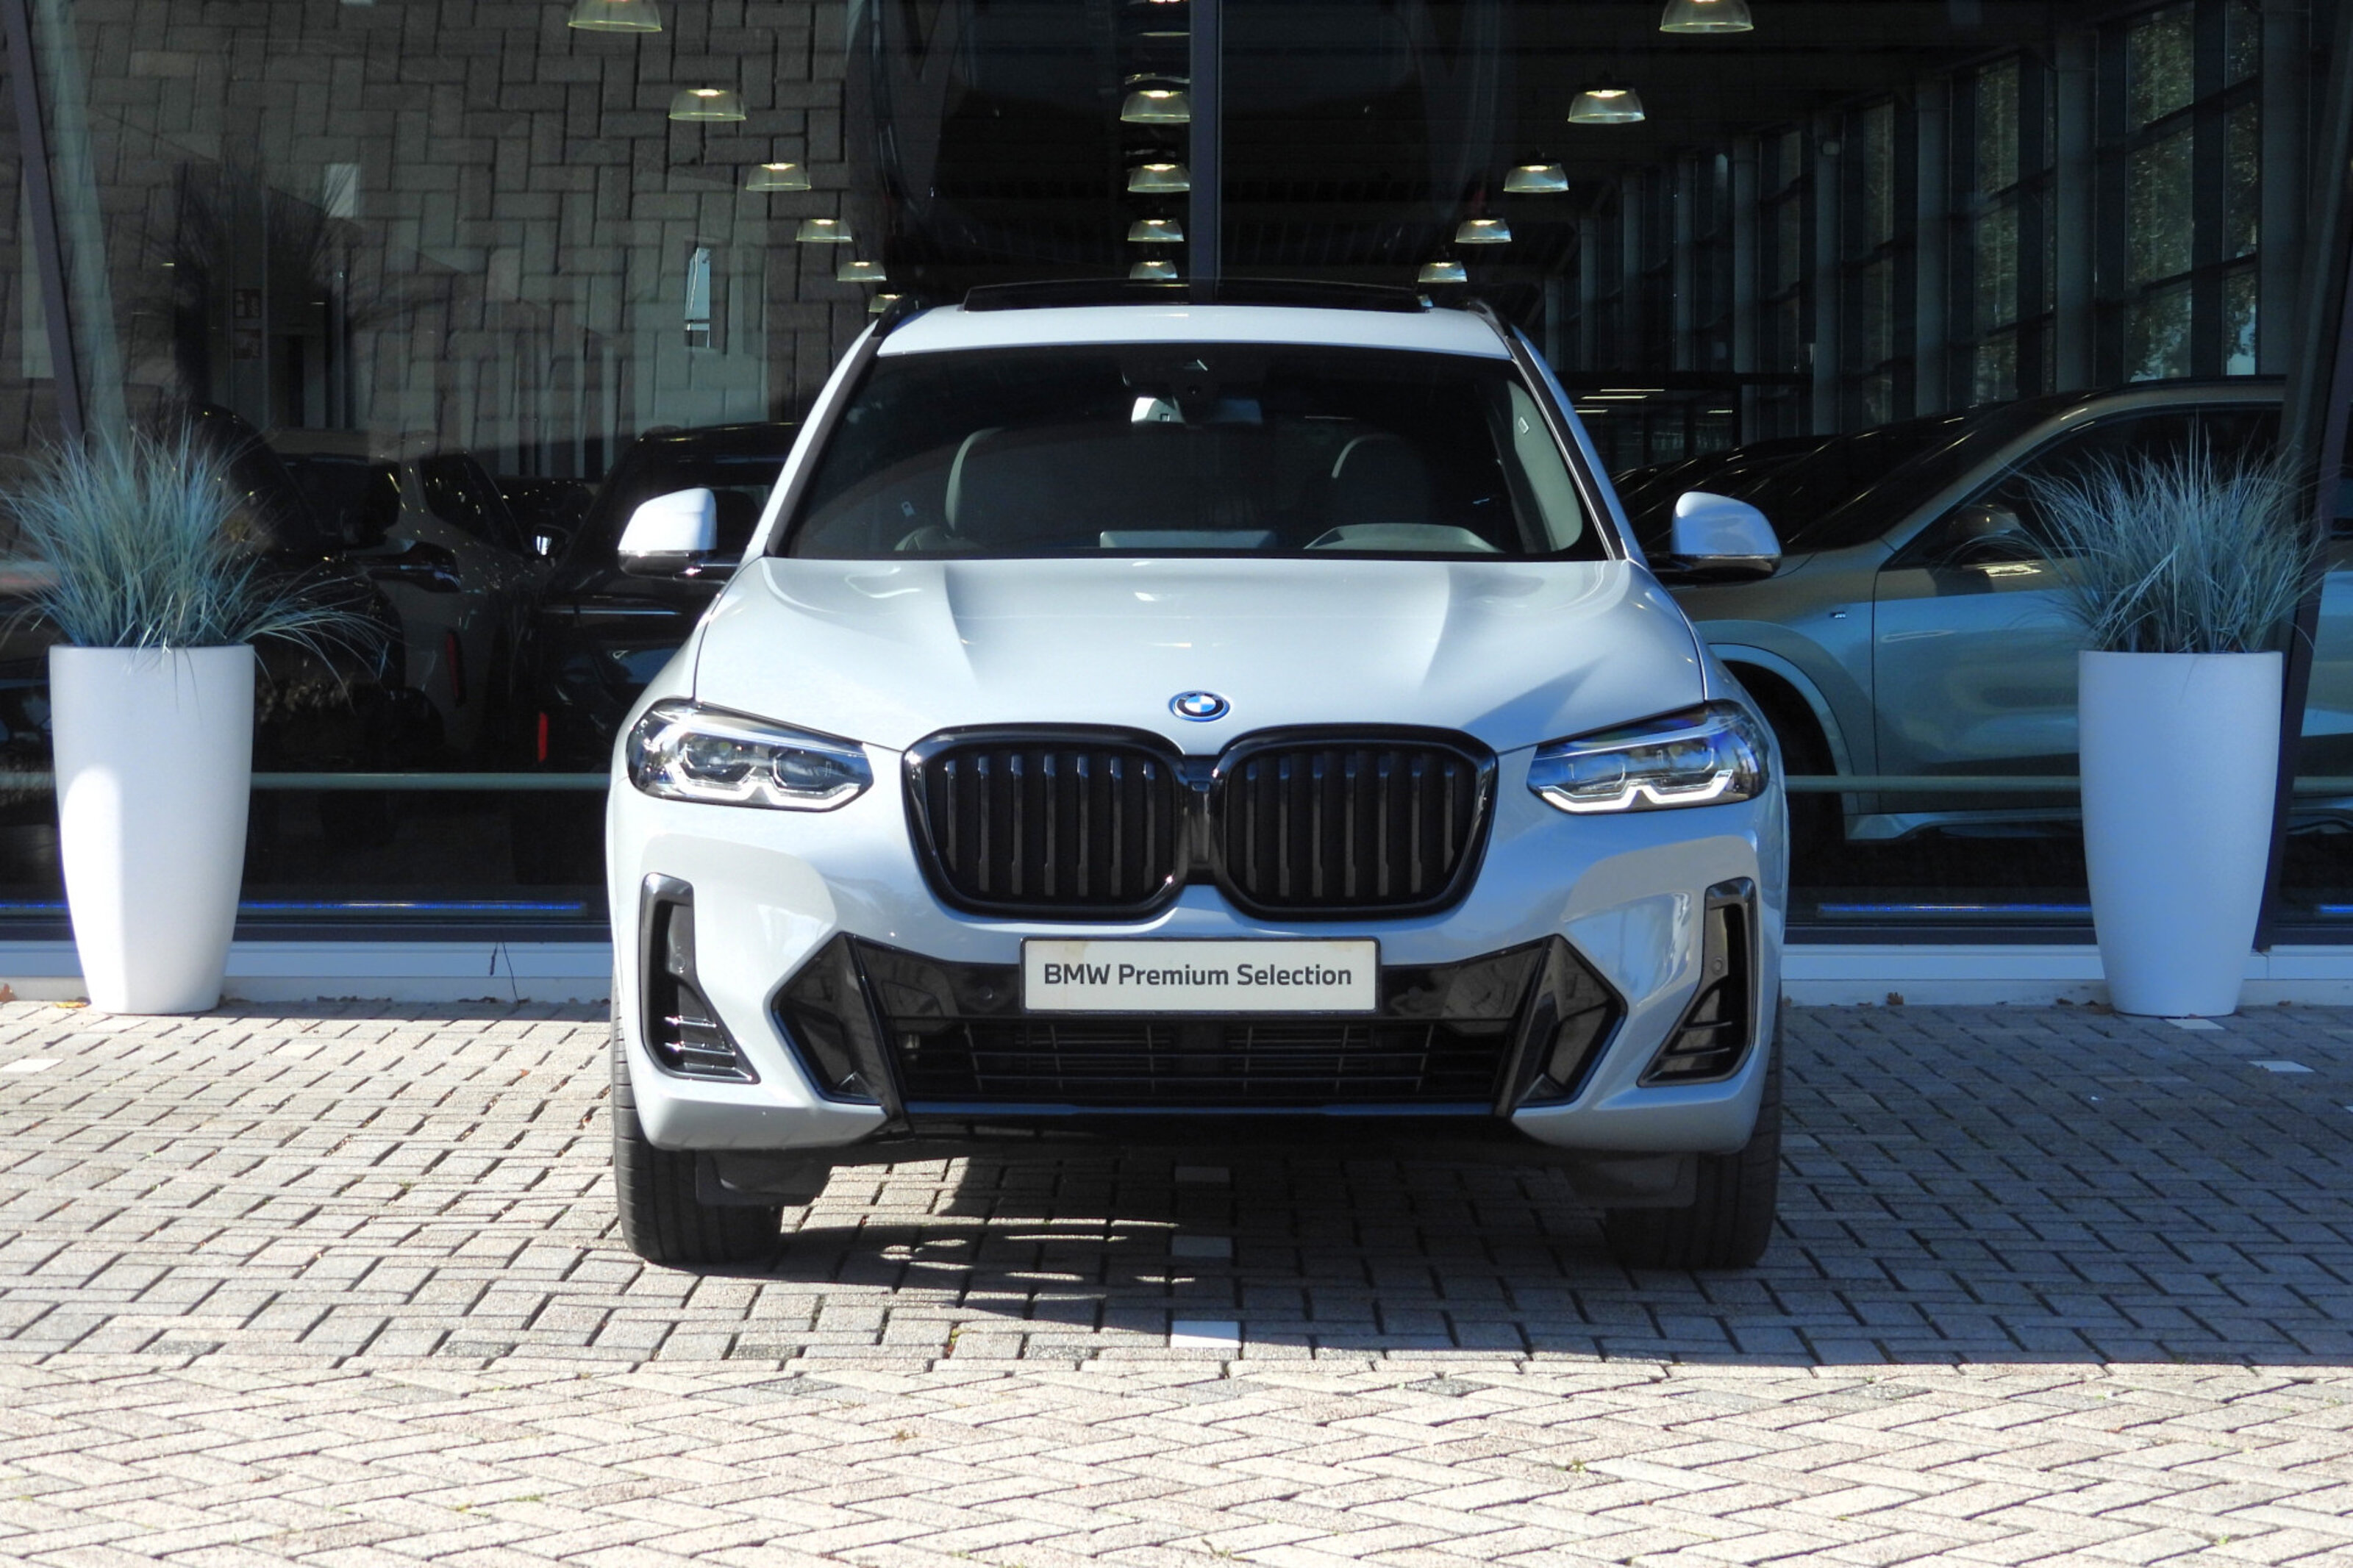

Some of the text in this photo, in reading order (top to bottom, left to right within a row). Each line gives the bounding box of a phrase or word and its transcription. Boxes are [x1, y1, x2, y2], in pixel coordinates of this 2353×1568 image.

[1044, 963, 1352, 986] BMW Premium Selection
